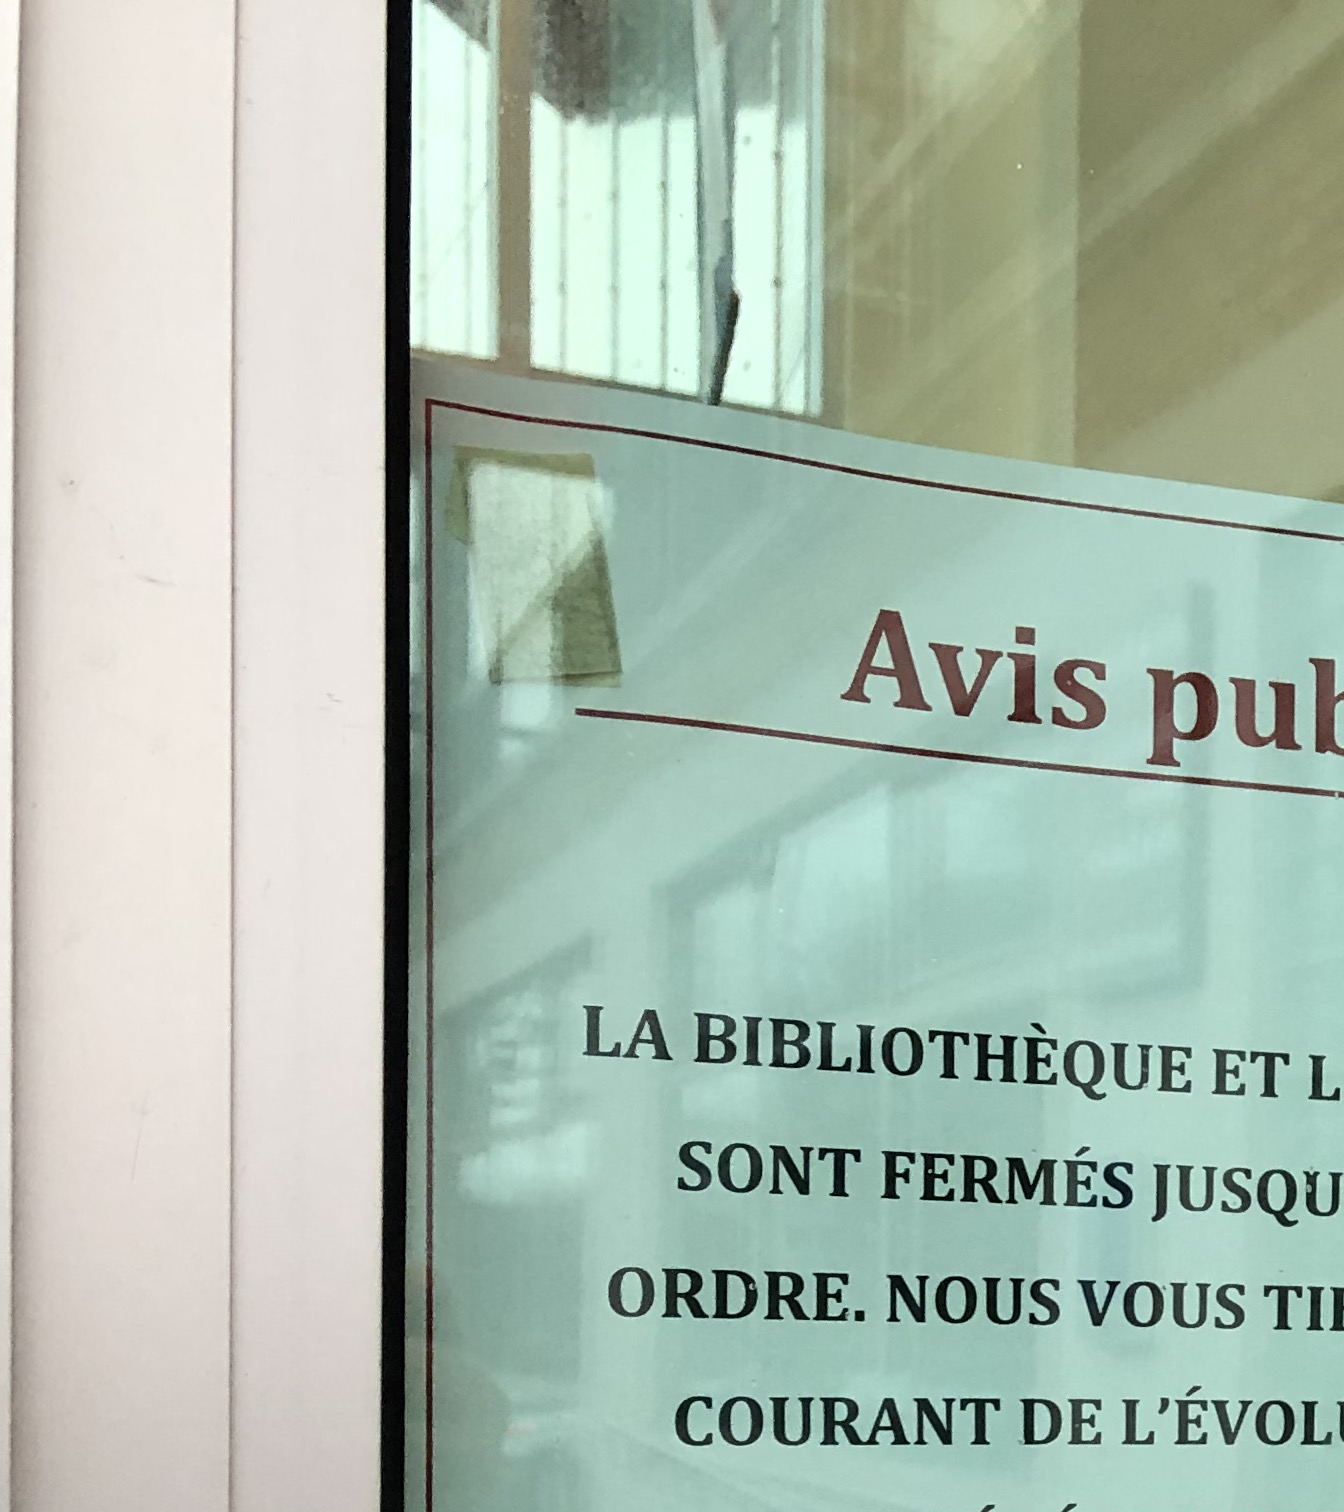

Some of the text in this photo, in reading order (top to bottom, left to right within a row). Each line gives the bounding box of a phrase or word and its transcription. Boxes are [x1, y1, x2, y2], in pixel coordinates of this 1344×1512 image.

[840, 608, 1108, 732] Avis
[582, 1005, 673, 1060] LA
[694, 1012, 1192, 1100] BIBLIOTHÈQUE
[1212, 1049, 1290, 1098] ET
[677, 1141, 861, 1197] SONT
[881, 1146, 1133, 1209] FERMÉS
[608, 1266, 866, 1322] ORDRE.
[887, 1274, 1061, 1326] NOUS
[1078, 1279, 1245, 1330] VOUS
[674, 1396, 1000, 1446] COURANT
[1021, 1398, 1102, 1445] DE
